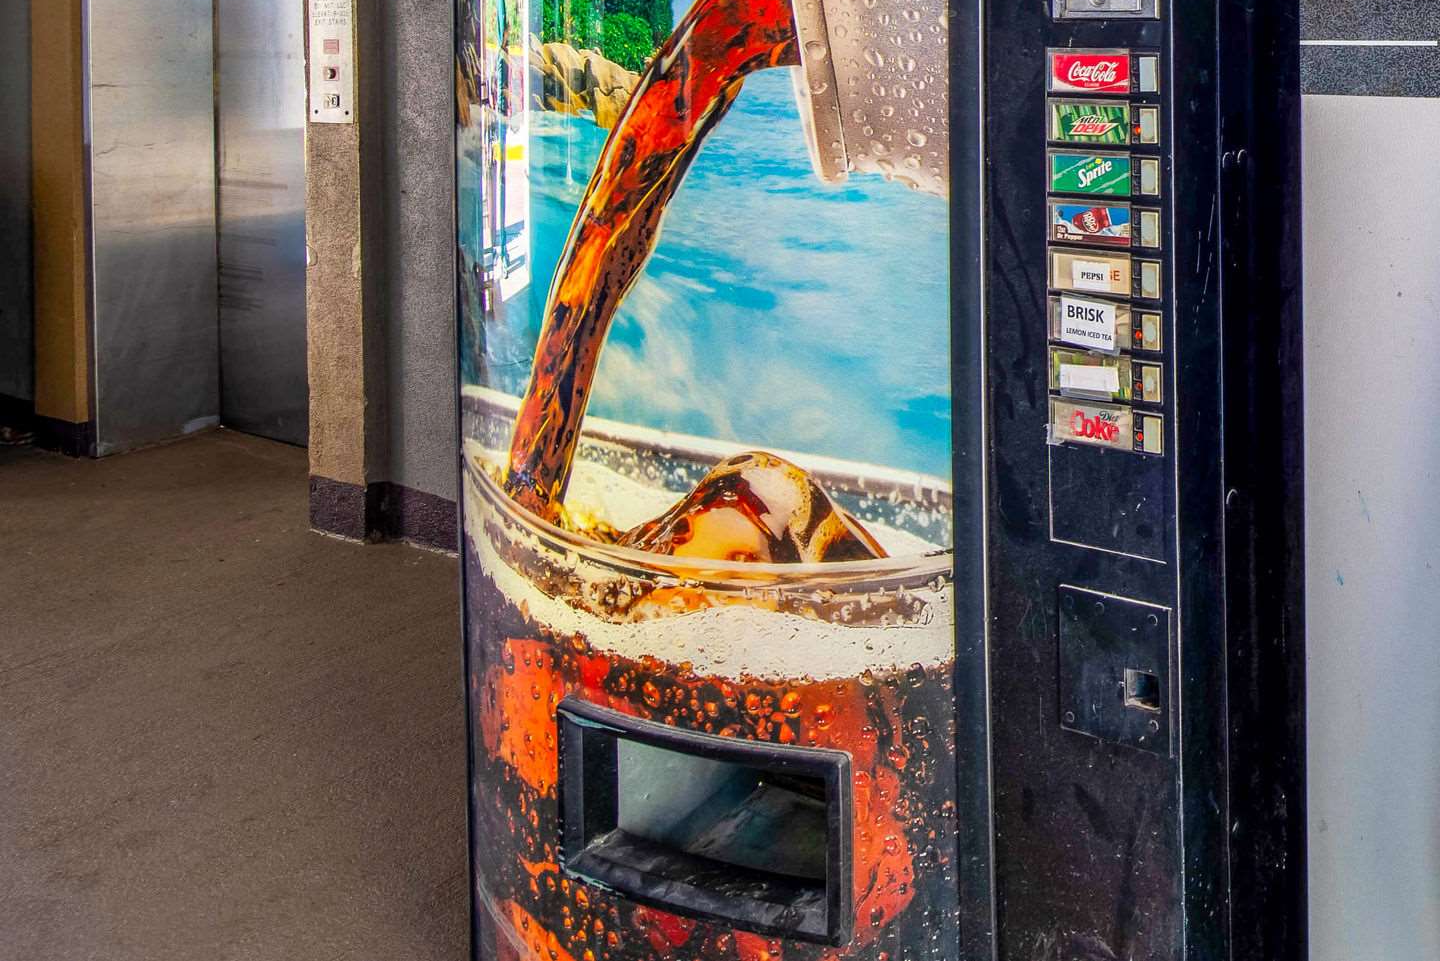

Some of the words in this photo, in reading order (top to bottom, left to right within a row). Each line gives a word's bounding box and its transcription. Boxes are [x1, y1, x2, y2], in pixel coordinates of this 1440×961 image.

[1067, 60, 1120, 82] Coca-Cola
[1077, 160, 1113, 188] Sprite
[1081, 271, 1104, 281] PEPSI
[1067, 304, 1105, 324] BRISK
[1066, 327, 1087, 337] LEMON
[1087, 330, 1101, 339] ICED
[1102, 333, 1112, 341] TEA
